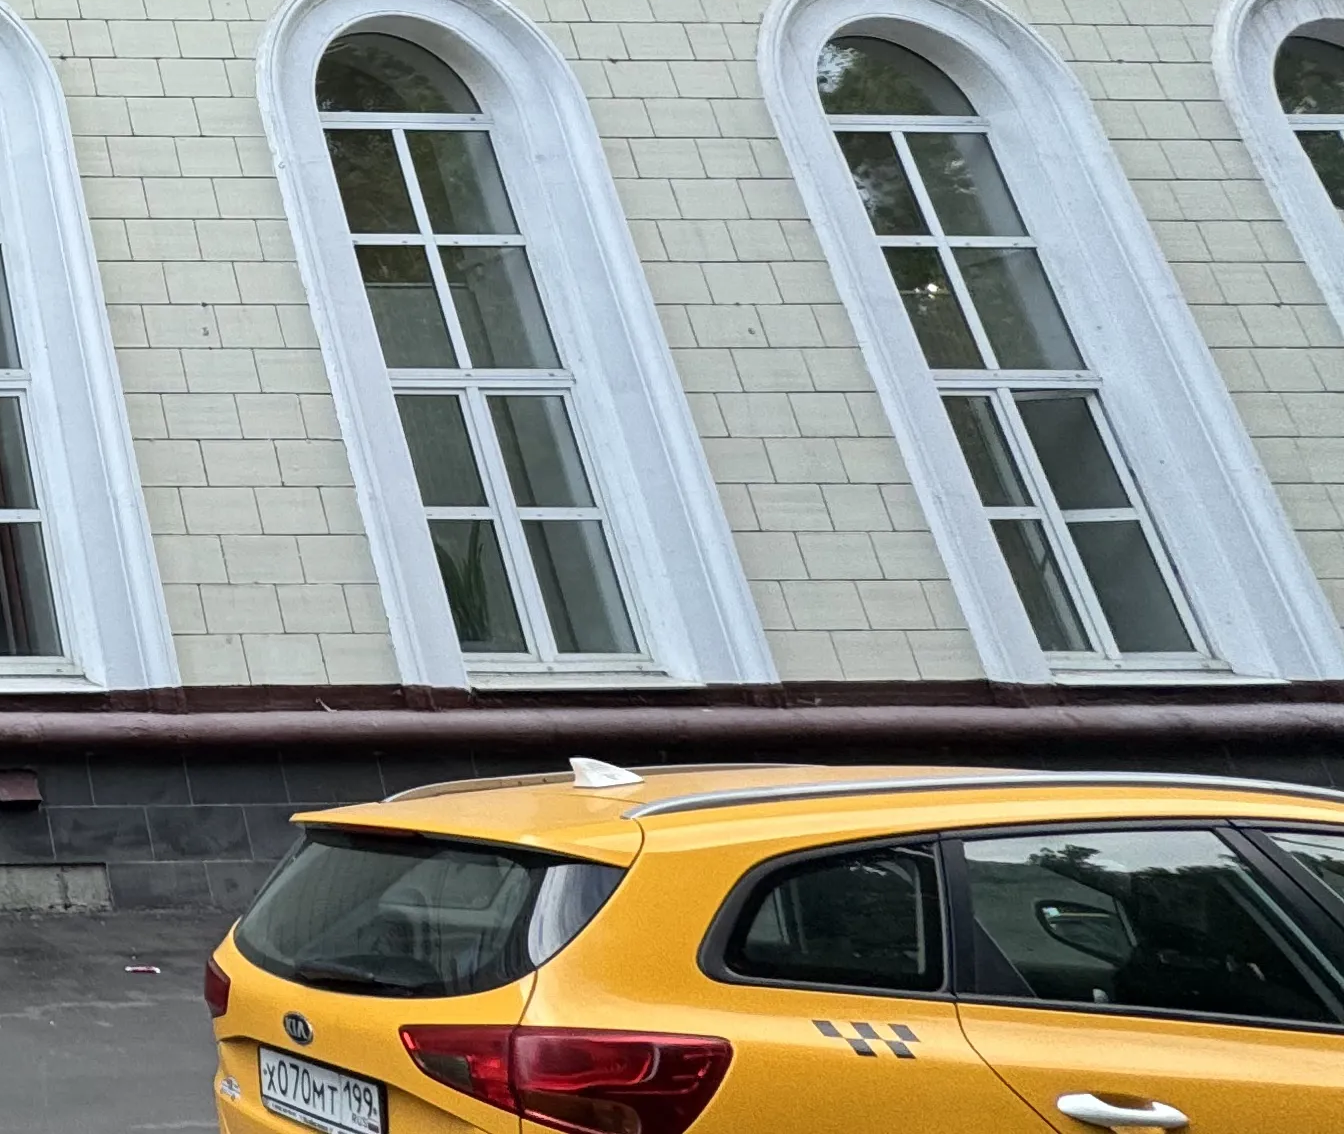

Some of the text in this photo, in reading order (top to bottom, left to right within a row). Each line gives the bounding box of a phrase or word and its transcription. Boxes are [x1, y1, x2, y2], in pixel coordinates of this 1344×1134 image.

[285, 1015, 309, 1040] KIA
[343, 1081, 374, 1117] 199
[352, 1114, 368, 1128] RUS
